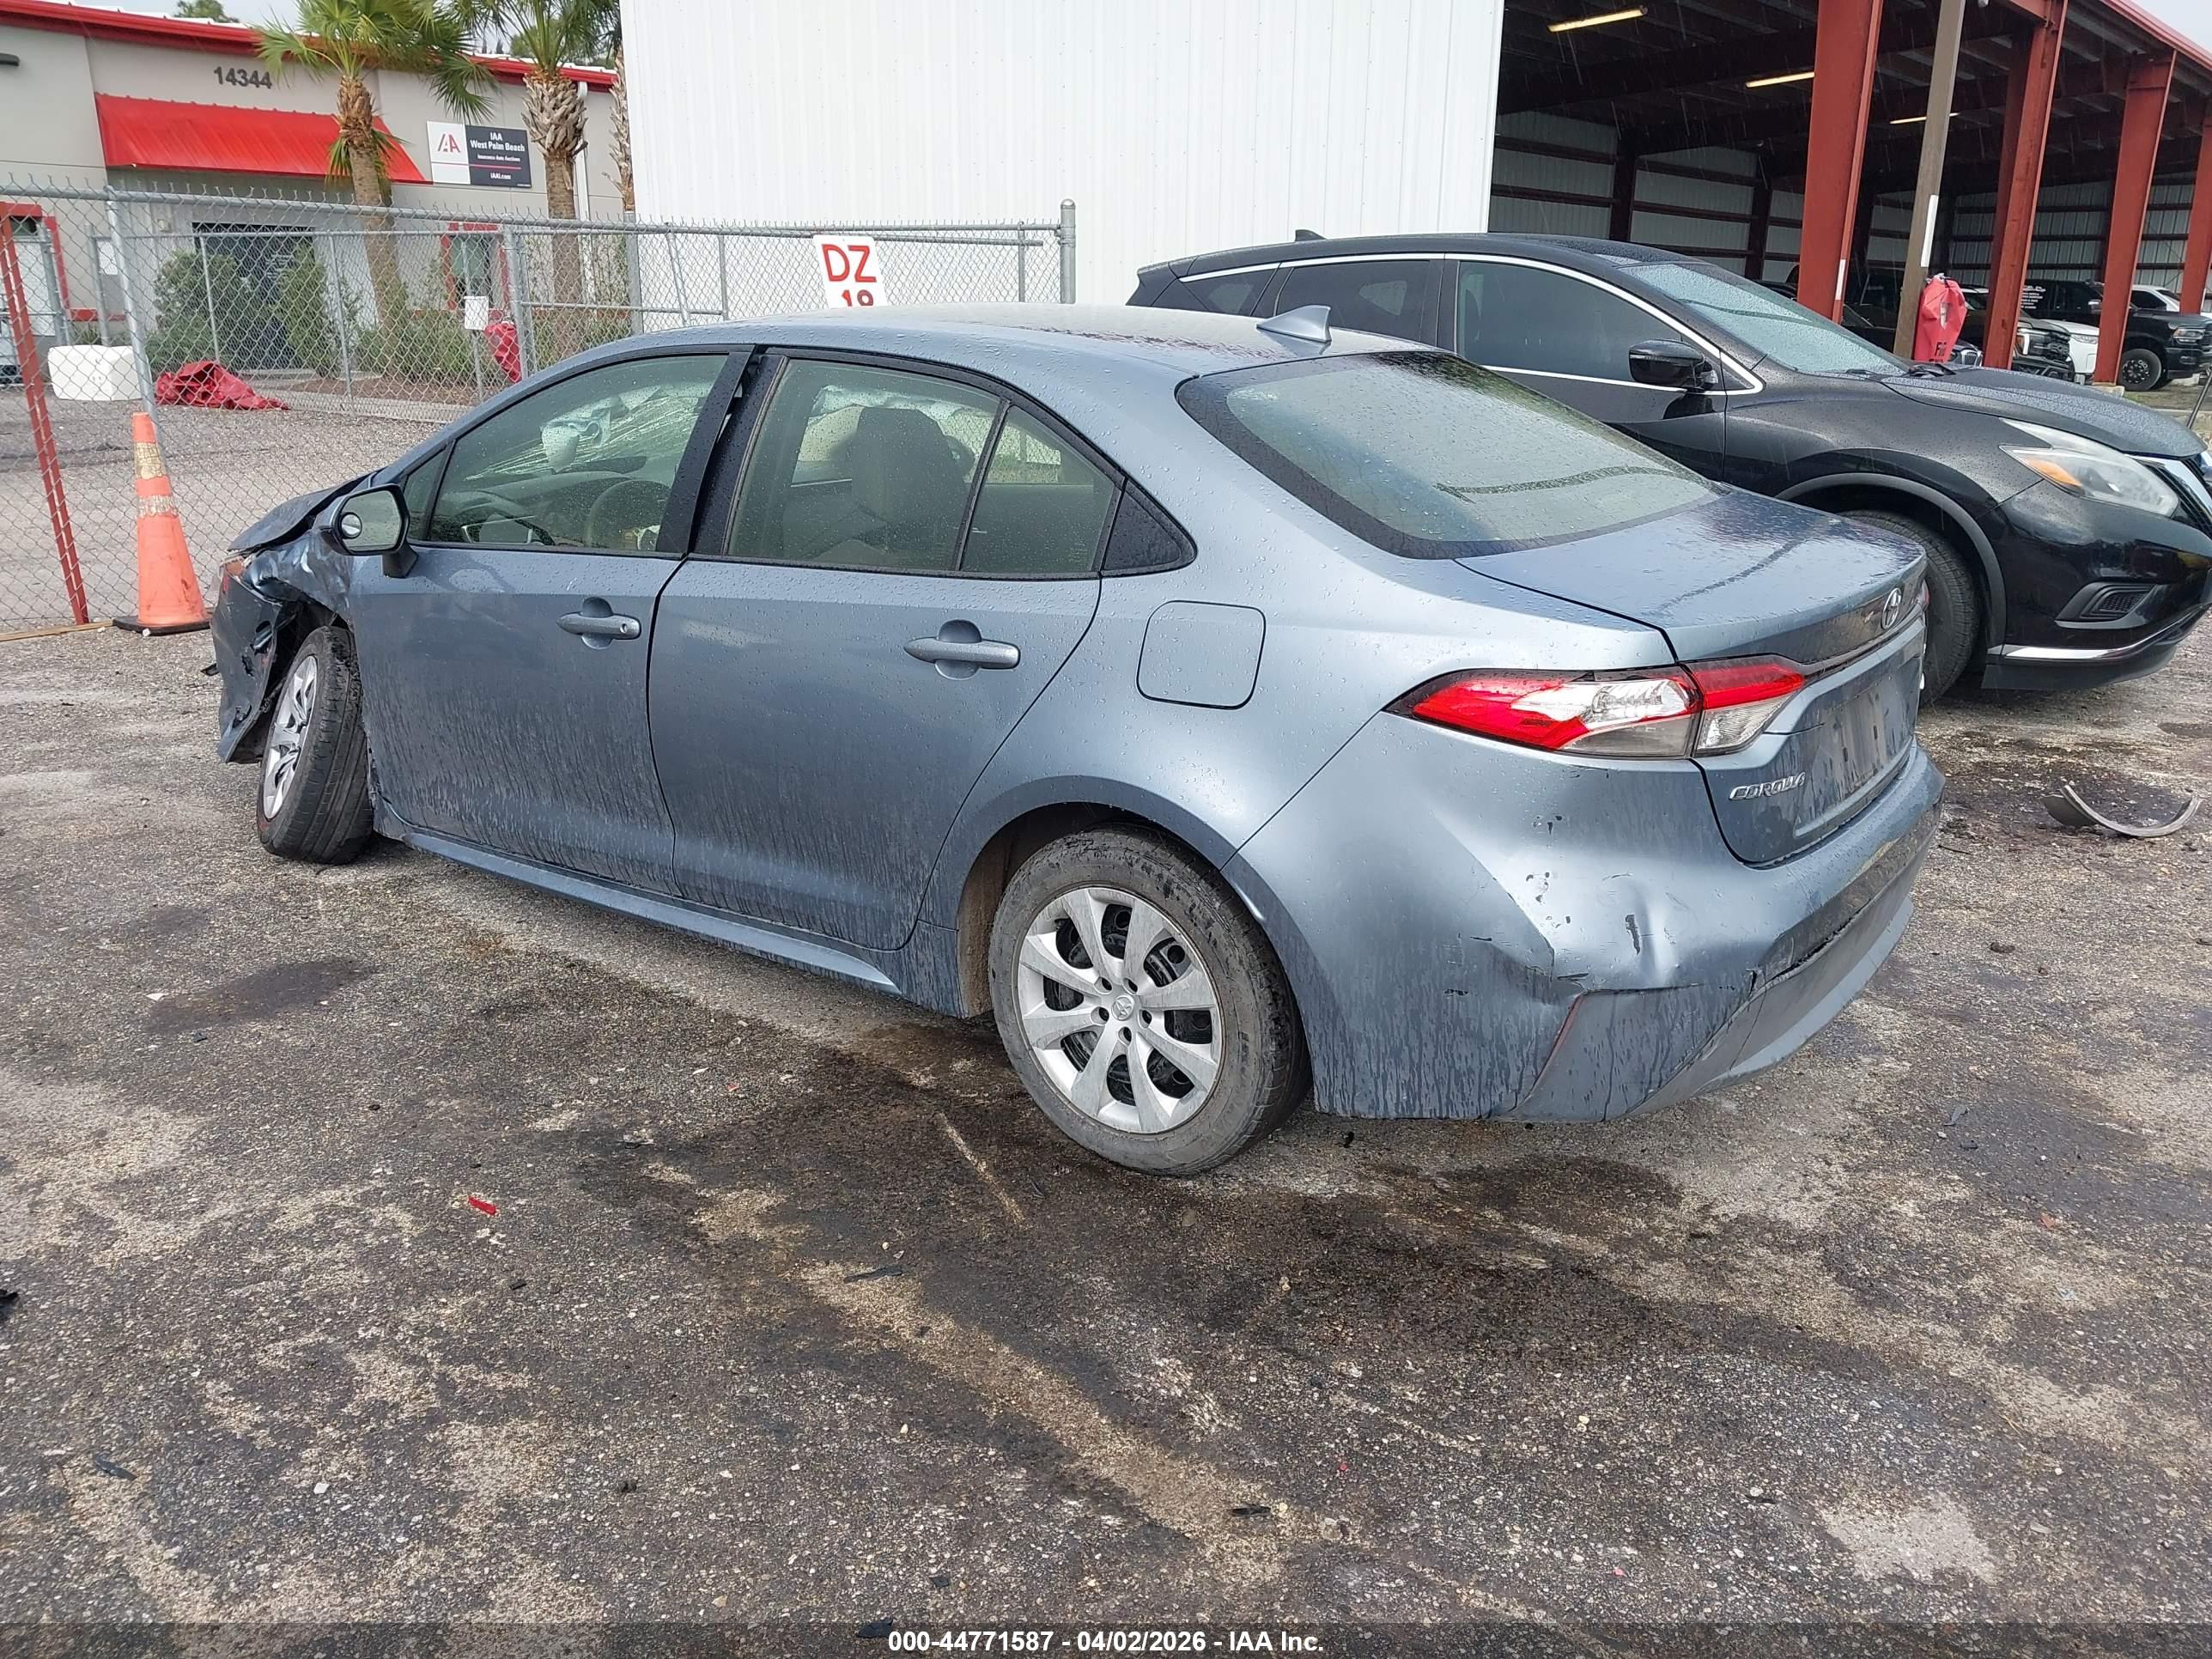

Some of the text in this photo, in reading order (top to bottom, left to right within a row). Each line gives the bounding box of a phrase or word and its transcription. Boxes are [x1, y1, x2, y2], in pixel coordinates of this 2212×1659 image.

[214, 66, 272, 89] 14344
[470, 140, 525, 152] West Palm Beach
[489, 131, 502, 141] IAA
[822, 244, 877, 283] DZ
[1729, 771, 1806, 800] COROLLA
